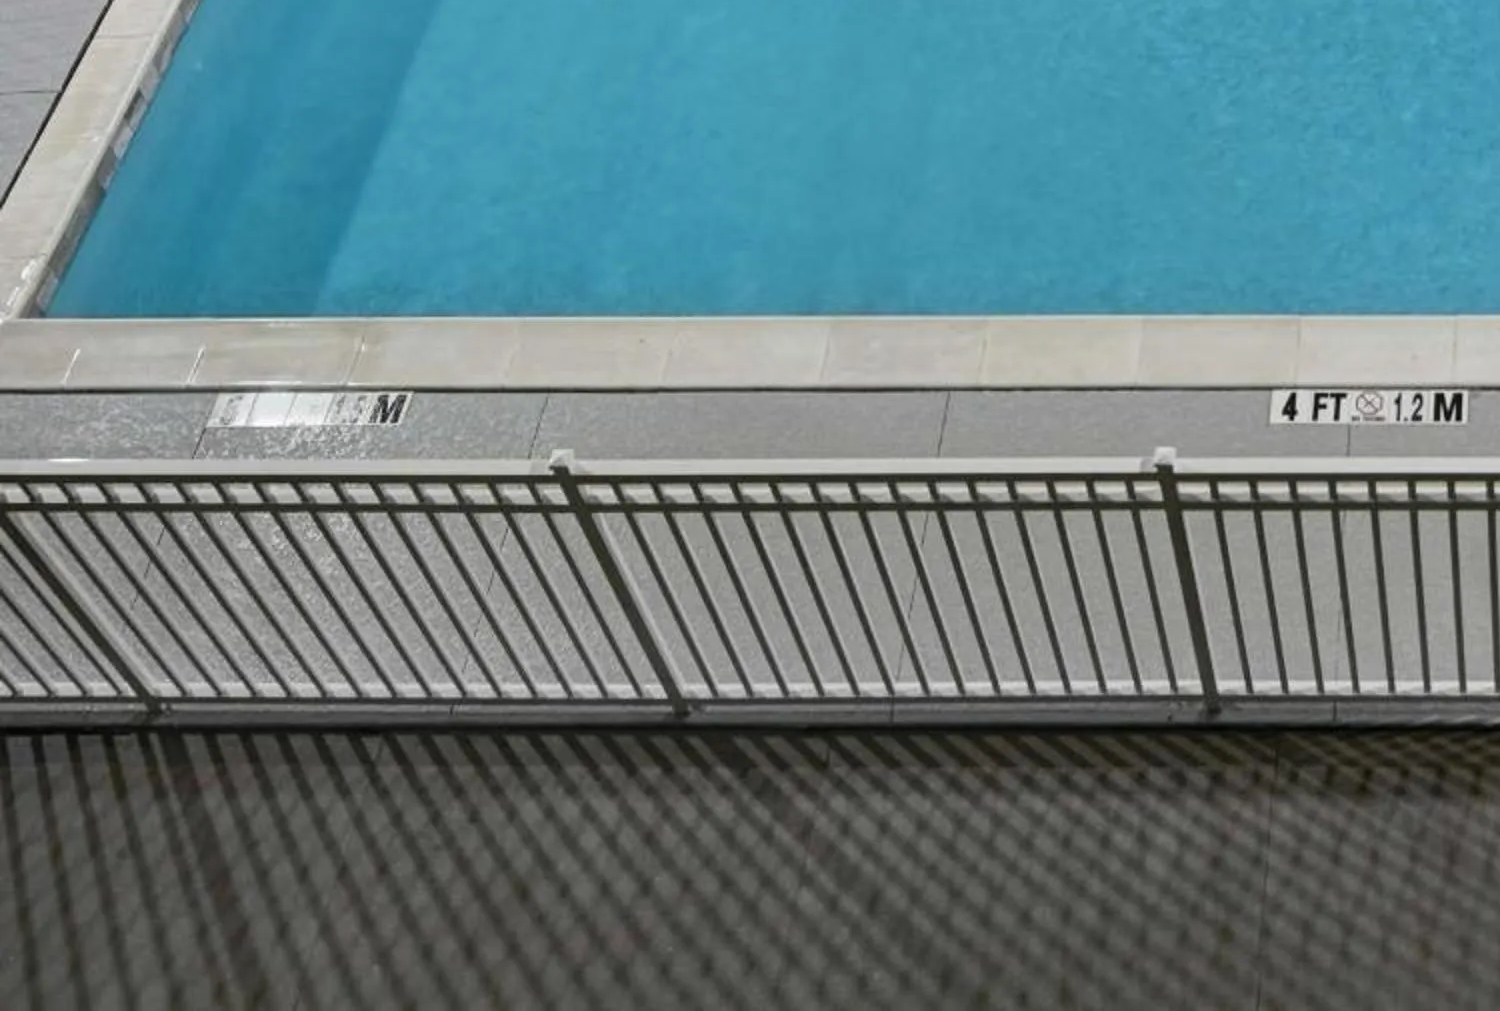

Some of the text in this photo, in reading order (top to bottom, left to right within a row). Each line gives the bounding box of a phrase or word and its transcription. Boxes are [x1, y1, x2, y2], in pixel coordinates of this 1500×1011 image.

[368, 395, 407, 424] M
[1281, 393, 1463, 422] 4 FT 1.2 M
